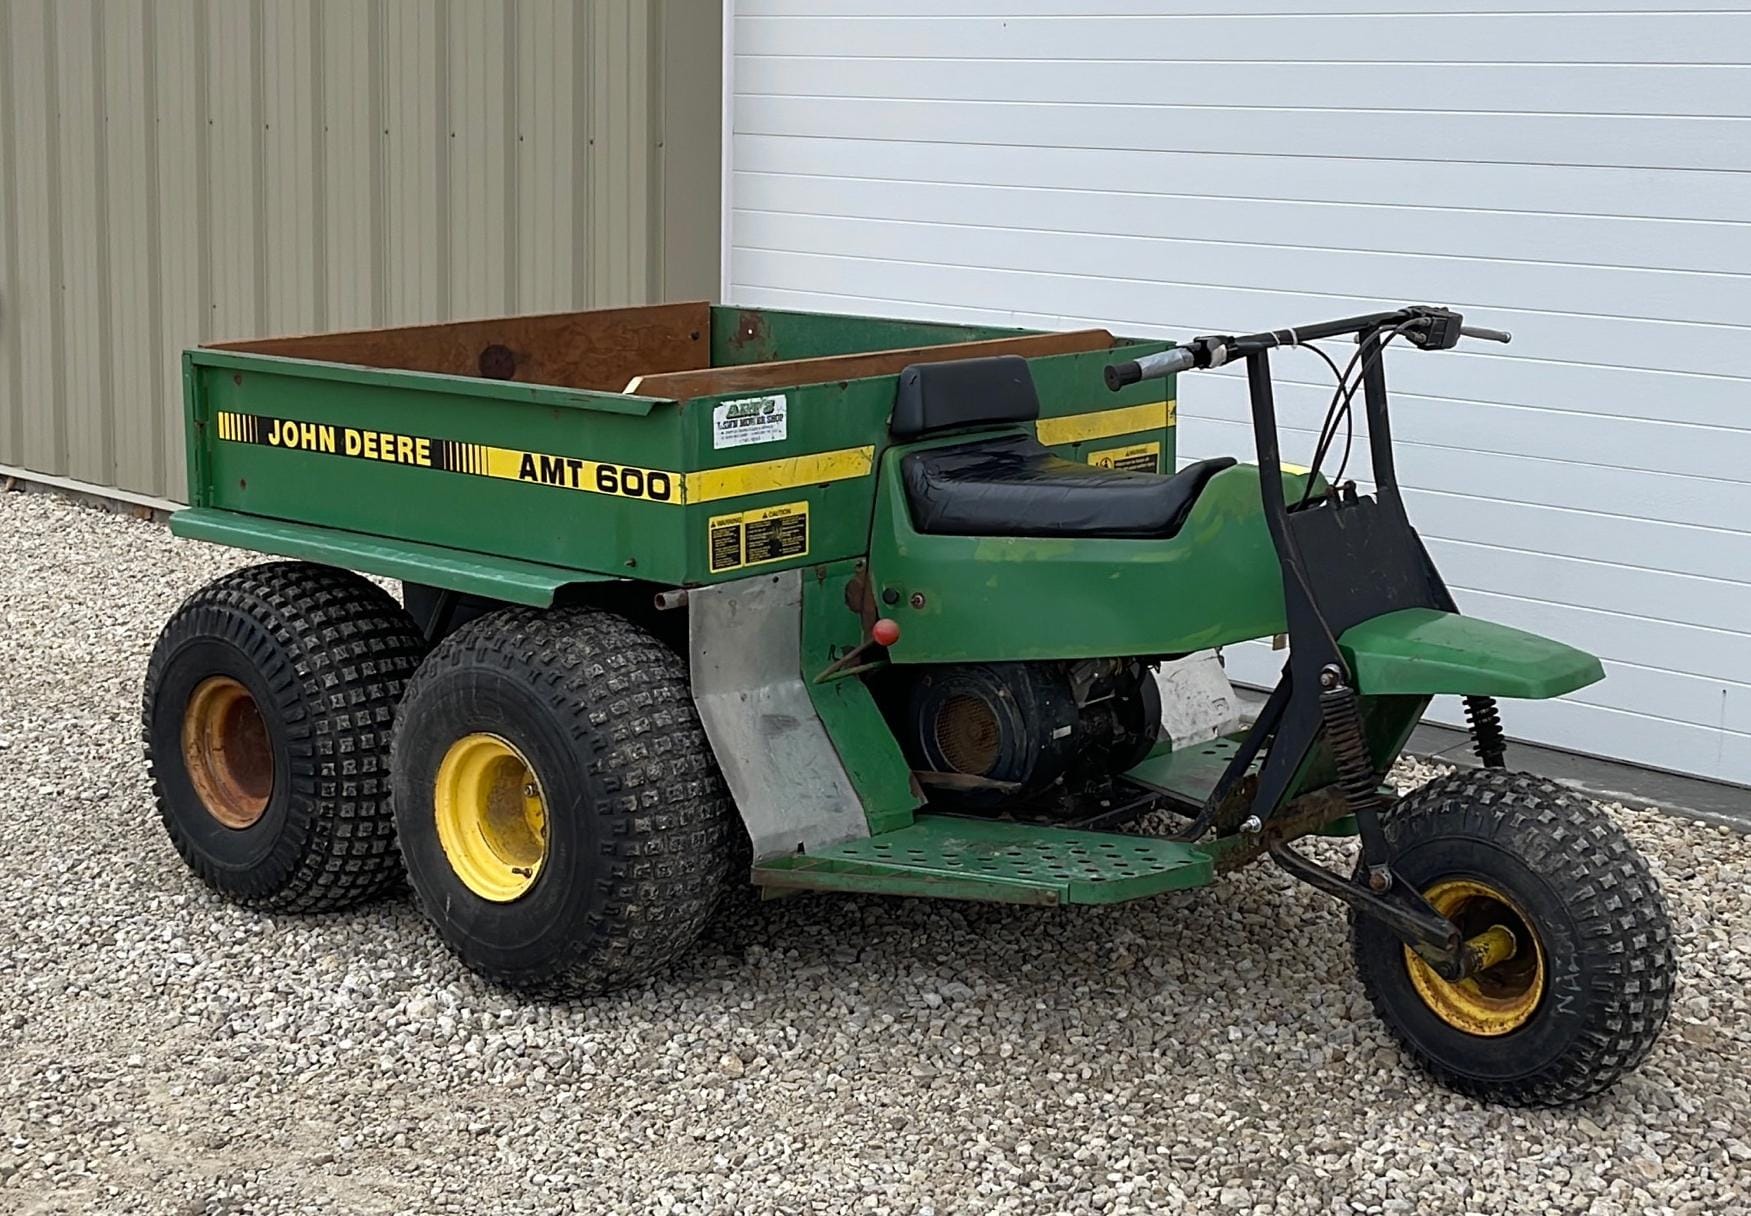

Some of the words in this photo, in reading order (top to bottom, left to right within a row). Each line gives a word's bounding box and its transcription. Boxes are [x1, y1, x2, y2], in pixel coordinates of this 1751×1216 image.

[268, 419, 335, 453] JOHN
[345, 428, 432, 467] DEERE
[519, 453, 584, 487] AMT
[596, 464, 671, 501] 600
[769, 508, 792, 518] CAUTION
